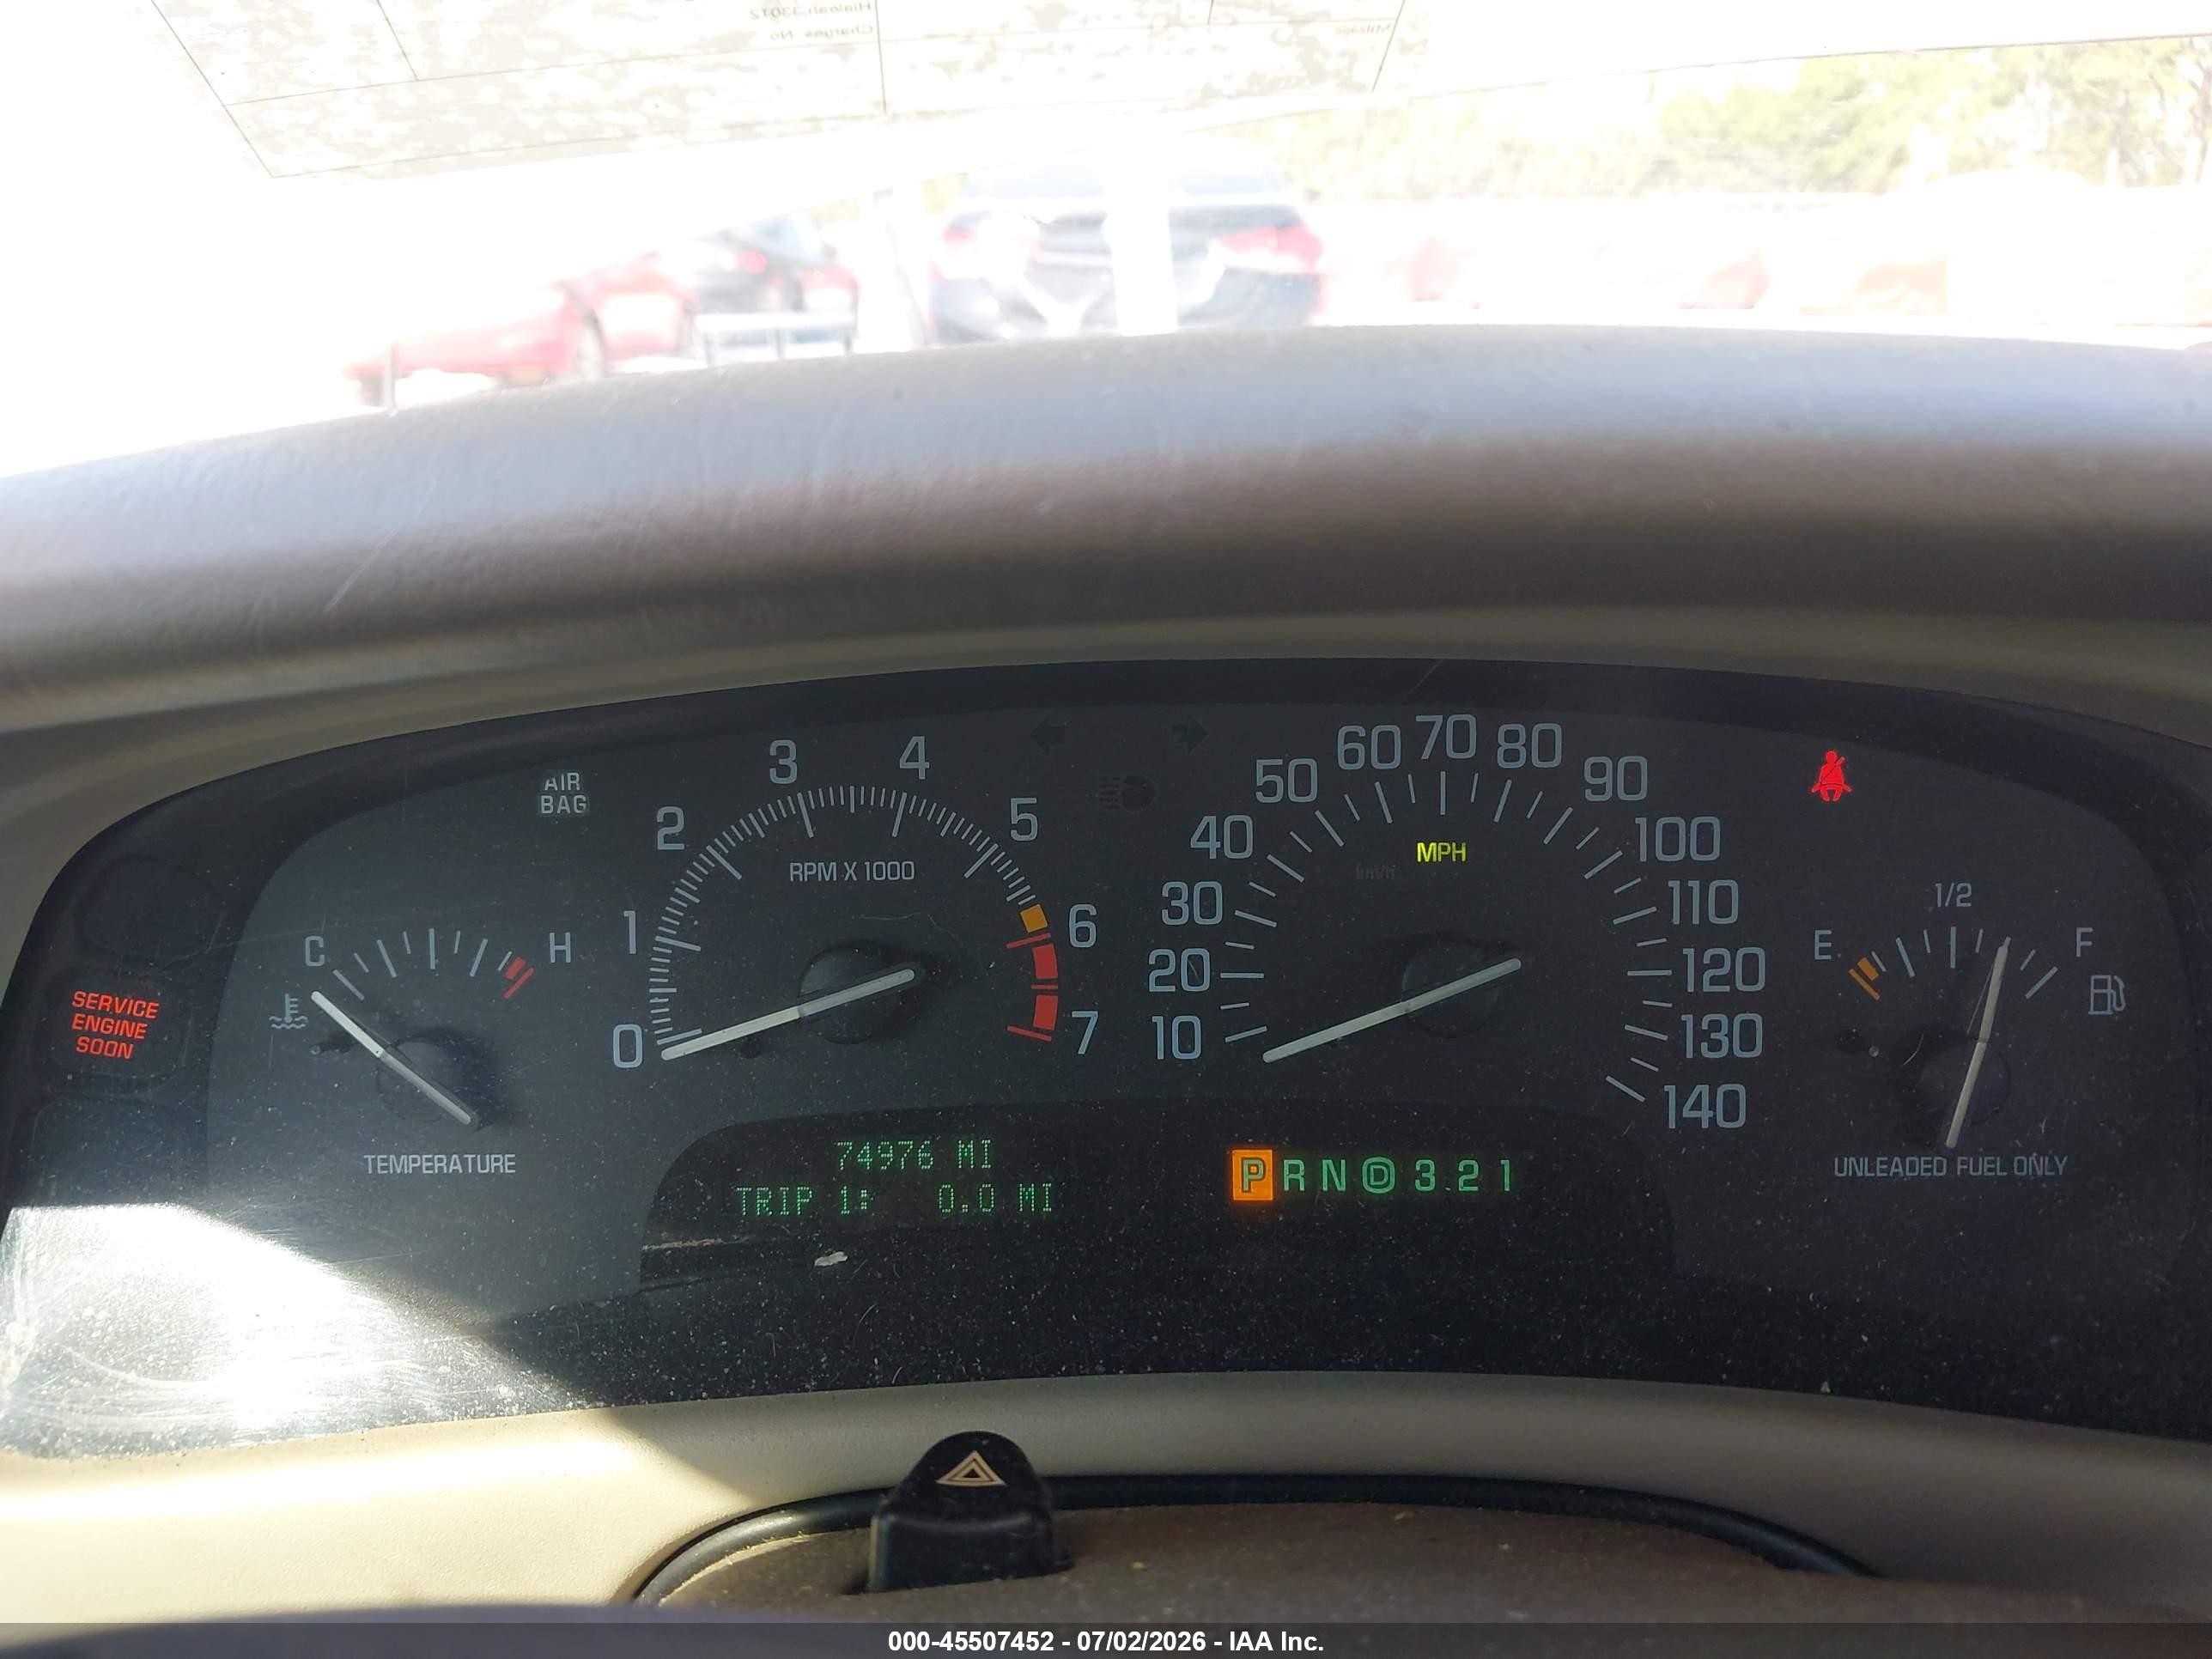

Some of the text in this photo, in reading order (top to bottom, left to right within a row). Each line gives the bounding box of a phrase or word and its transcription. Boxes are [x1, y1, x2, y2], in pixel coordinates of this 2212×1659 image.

[898, 735, 930, 781] 4
[1335, 724, 1402, 770] 60
[1414, 714, 1478, 760] 70
[1496, 722, 1563, 769] 80
[544, 772, 581, 791] AIR
[769, 739, 799, 785] 3
[1255, 757, 1319, 804] 50
[1583, 755, 1649, 802] 90
[540, 795, 587, 814] BAG
[1010, 796, 1039, 842] 5
[656, 805, 686, 850] 2
[1189, 814, 1255, 860] 40
[1635, 815, 1722, 862] 100
[789, 860, 915, 882] RPM X 1000
[1417, 842, 1467, 862] MPH
[1161, 881, 1224, 927] 30
[1668, 879, 1740, 926] 110
[1935, 883, 1973, 907] 1/2
[550, 932, 572, 963] H
[623, 910, 638, 955] 1
[1068, 903, 1097, 948] 6
[1814, 929, 1832, 960] E
[2076, 927, 2094, 957] F
[305, 935, 325, 967] C
[1148, 948, 1212, 994] 20
[1681, 946, 1766, 994] 120
[71, 1012, 149, 1040] ENGINE
[72, 990, 160, 1019] SERVICE
[76, 1036, 134, 1060] SOON
[612, 1024, 644, 1068] 0
[1071, 1010, 1099, 1054] 7
[1152, 1015, 1203, 1060] 10
[1680, 1012, 1765, 1060] 130
[1663, 1084, 1747, 1130] 140
[364, 1153, 517, 1175] TEMPERATURE
[836, 1139, 992, 1170] 74976 MI
[1242, 1158, 1265, 1192] P
[1283, 1159, 1305, 1192] R
[1322, 1159, 1346, 1192] N
[1415, 1159, 1436, 1192] 3
[1458, 1159, 1480, 1192] 2
[1500, 1159, 1510, 1192] 1
[1834, 1154, 2069, 1177] UNLEADED FUEL ONLY
[737, 1182, 1053, 1216] TRIP 1: 0.0 MI
